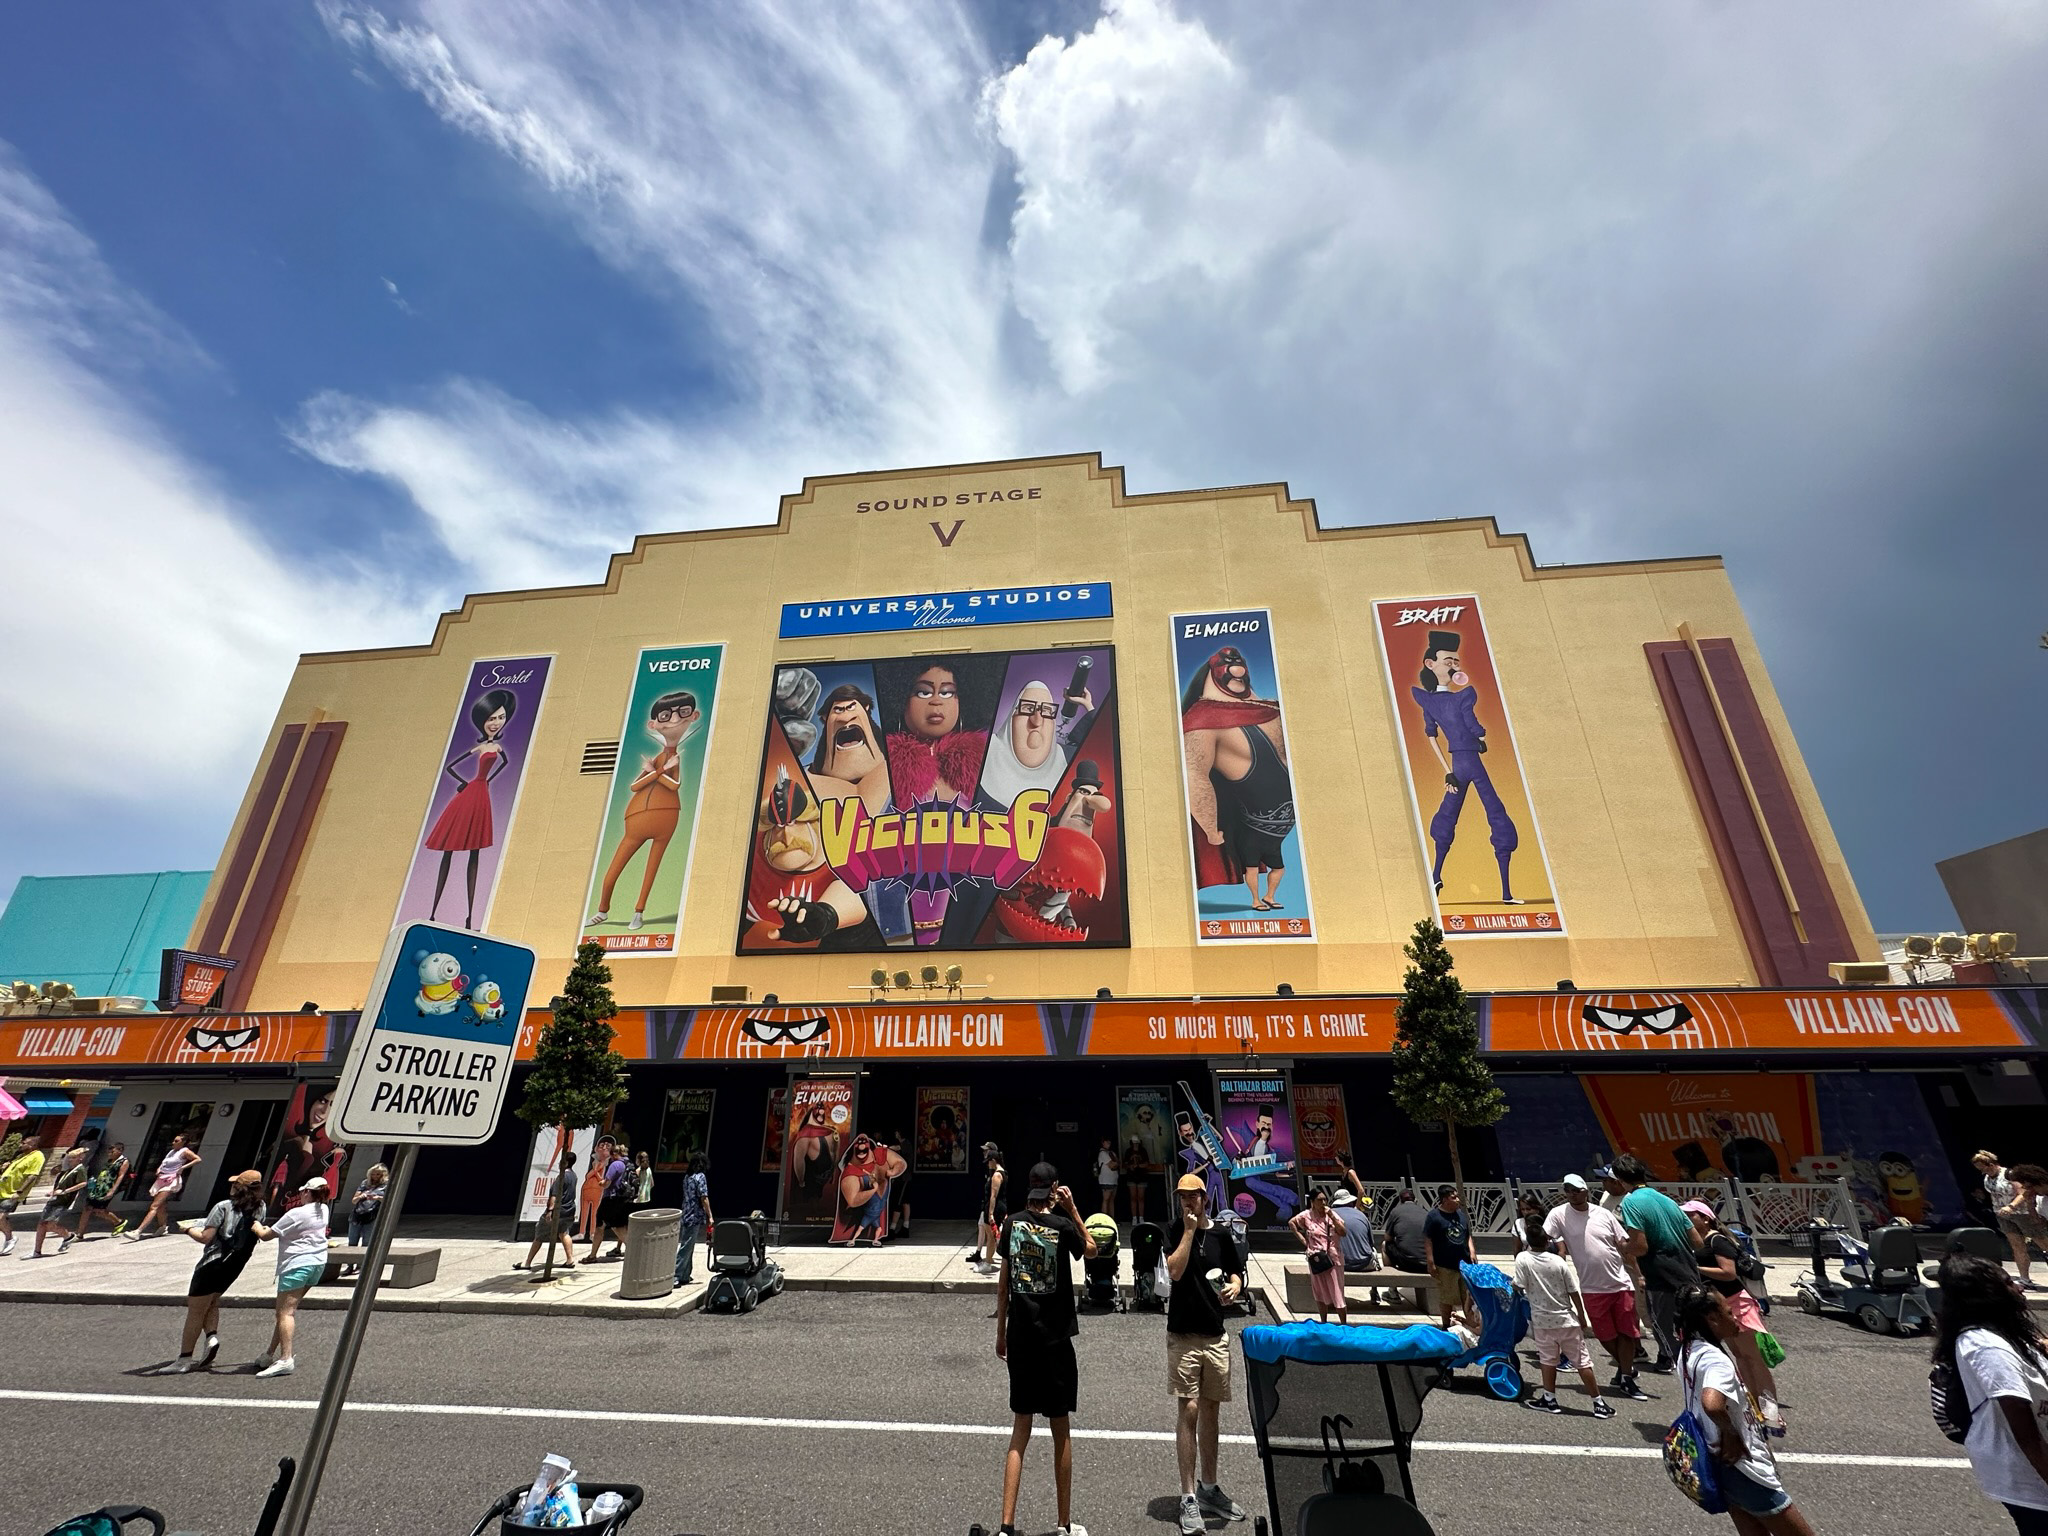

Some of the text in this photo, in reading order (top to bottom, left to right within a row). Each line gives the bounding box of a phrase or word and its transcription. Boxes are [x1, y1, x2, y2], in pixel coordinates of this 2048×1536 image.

[856, 488, 1042, 513] SOUND STAGE
[929, 519, 966, 547] V
[799, 588, 1092, 619] UNIVERSAL STUDIOS
[912, 605, 976, 627] Welcomes
[1391, 605, 1468, 627] BRATT
[1183, 620, 1260, 639] EL MACHO
[480, 664, 534, 688] Scarlet
[648, 658, 711, 673] VECTOR
[1229, 920, 1281, 934] VILLAIN-CON
[1473, 914, 1529, 929] VILLAIN-CON
[605, 935, 650, 949] VILLAIN-CON
[194, 967, 214, 981] EVIL
[185, 979, 214, 994] STUFF
[1784, 996, 1961, 1034] VILLAIN-CON
[873, 1013, 1004, 1048] VILLAIN-CON
[1148, 1013, 1369, 1042] SO MUCH FUN, IT'S A CRIME
[16, 1026, 127, 1057] VILLAIN-CON
[375, 1042, 497, 1083] STROLLER
[1220, 1080, 1285, 1092] BALTHAZAR BRATT
[1294, 1087, 1340, 1100] ILLAIN-CON
[1666, 1078, 1732, 1102] Welcome to
[370, 1081, 480, 1118] PARKING
[794, 1091, 808, 1105] EL
[808, 1090, 851, 1105] MACHO
[533, 1177, 549, 1196] OH
